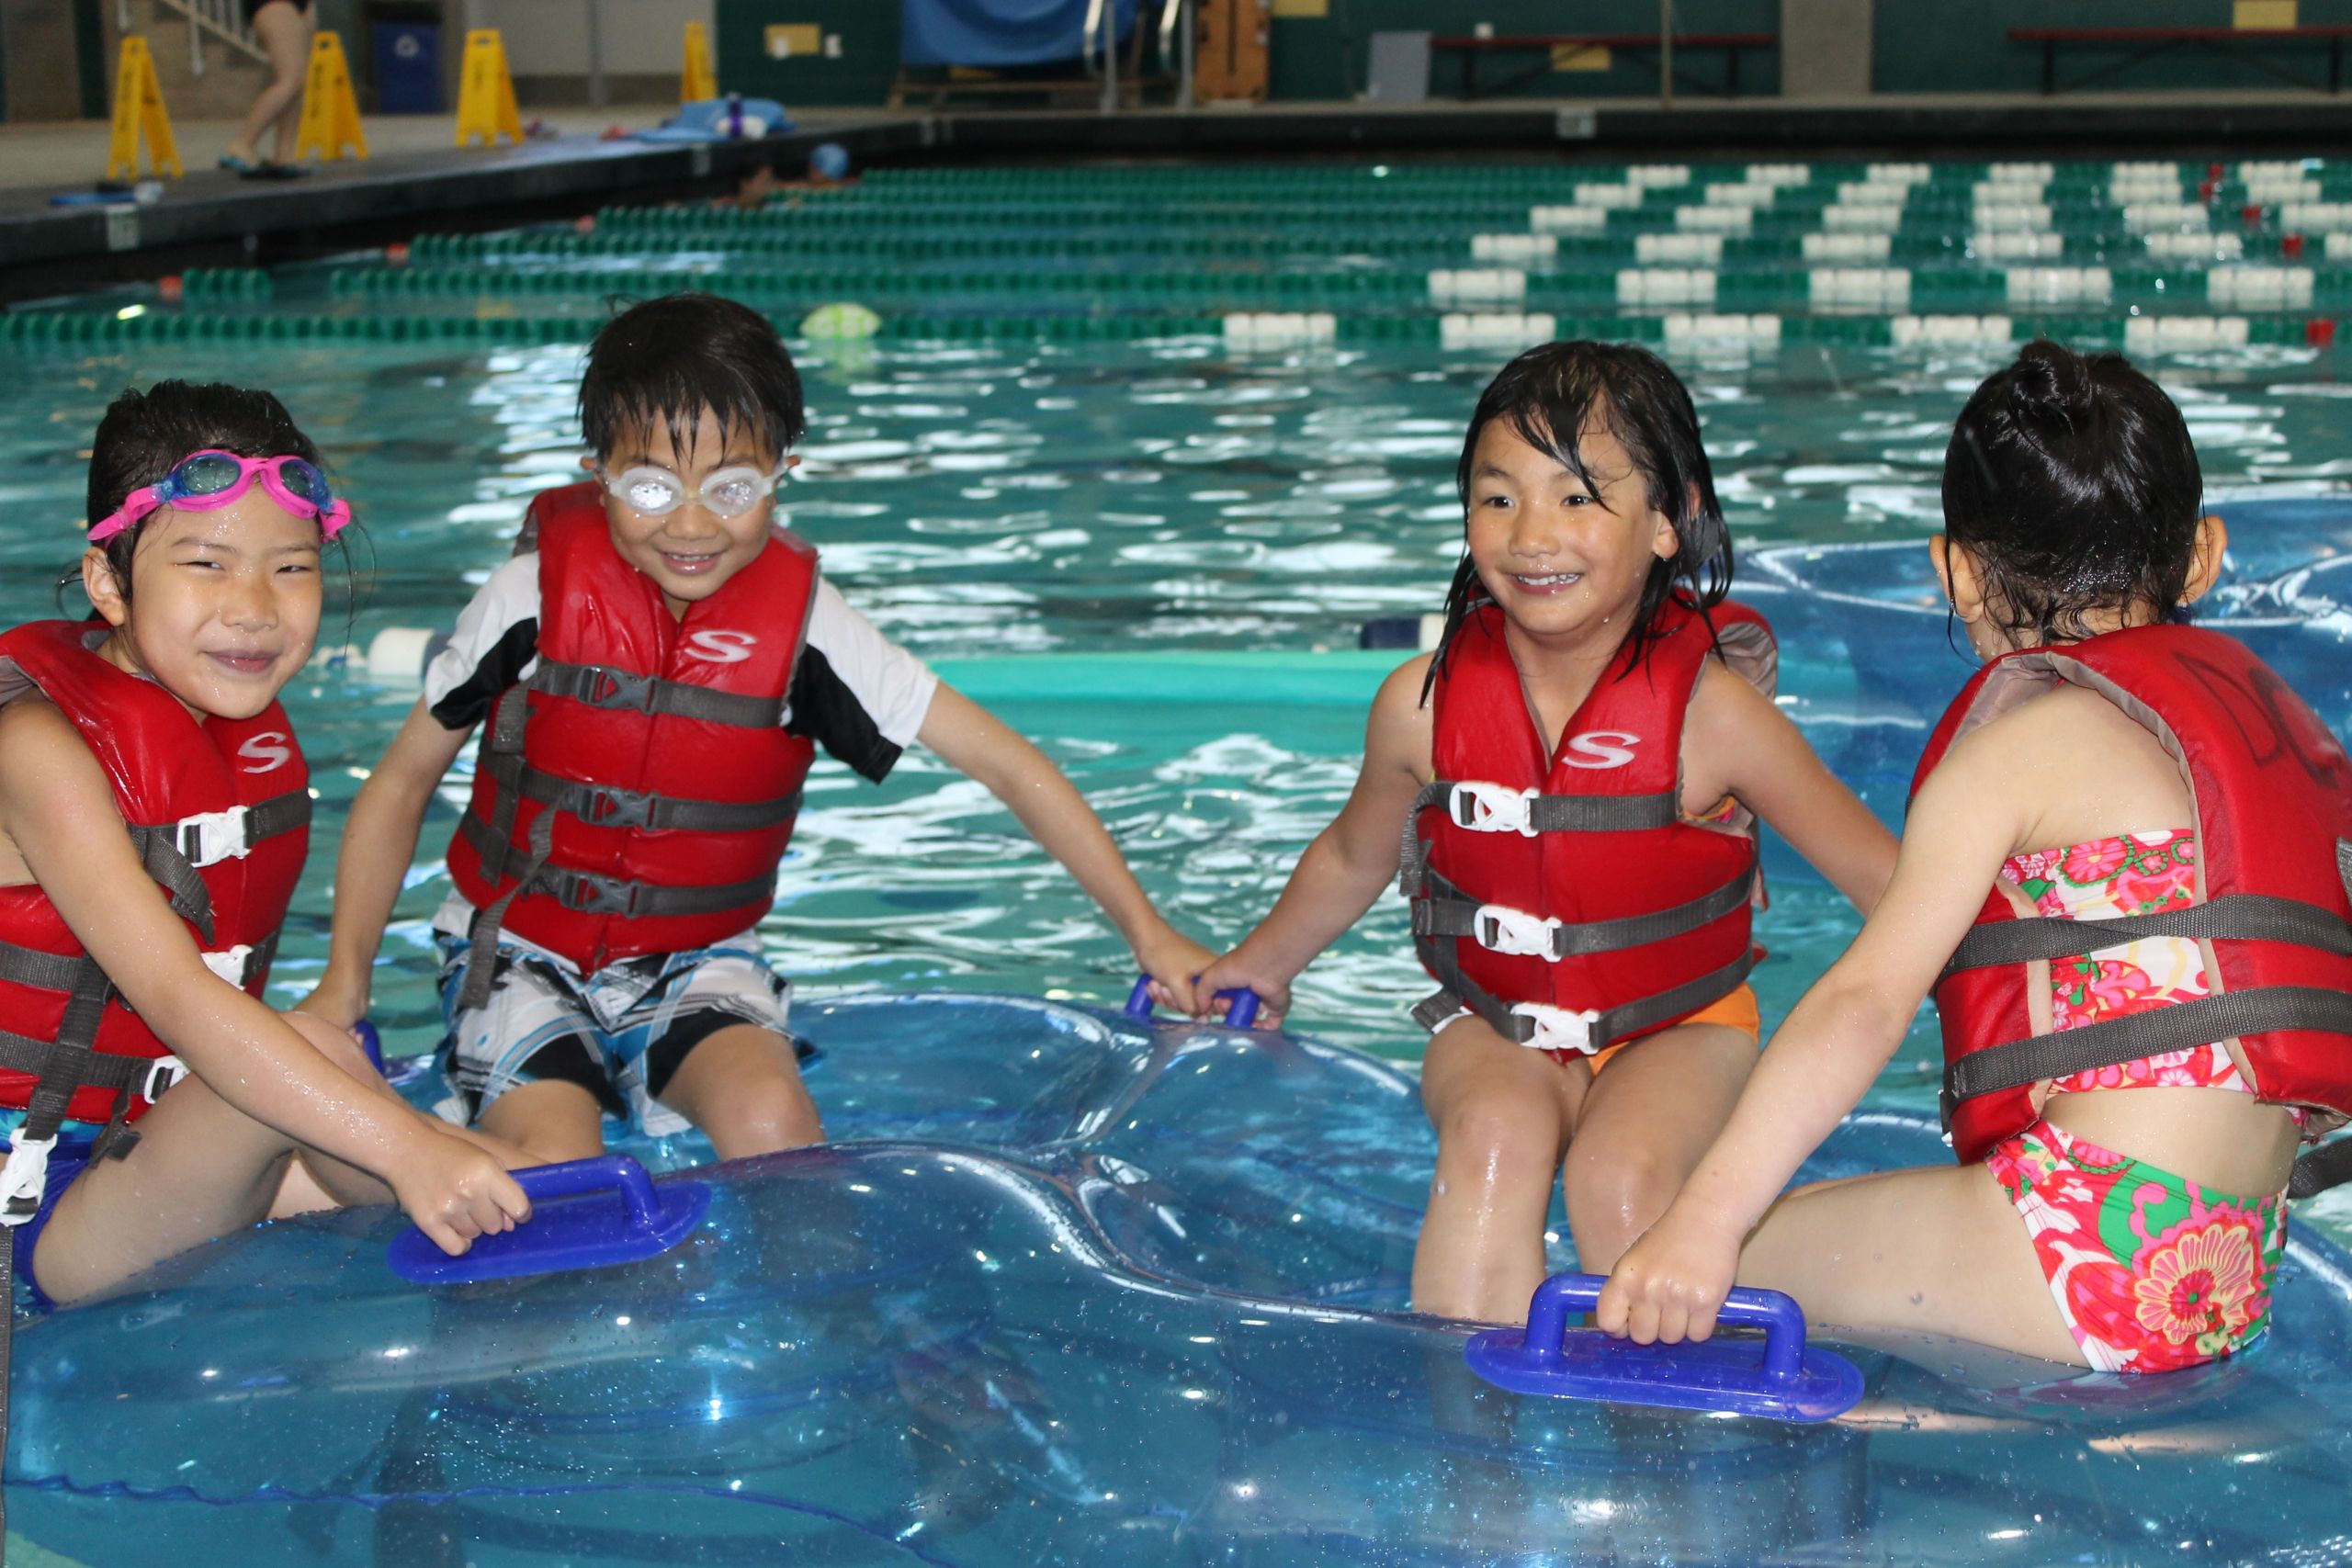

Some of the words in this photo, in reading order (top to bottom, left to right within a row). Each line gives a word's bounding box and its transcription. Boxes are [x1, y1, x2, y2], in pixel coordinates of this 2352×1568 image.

[684, 629, 757, 664] S
[237, 731, 290, 773] S
[1561, 729, 1643, 770] S
